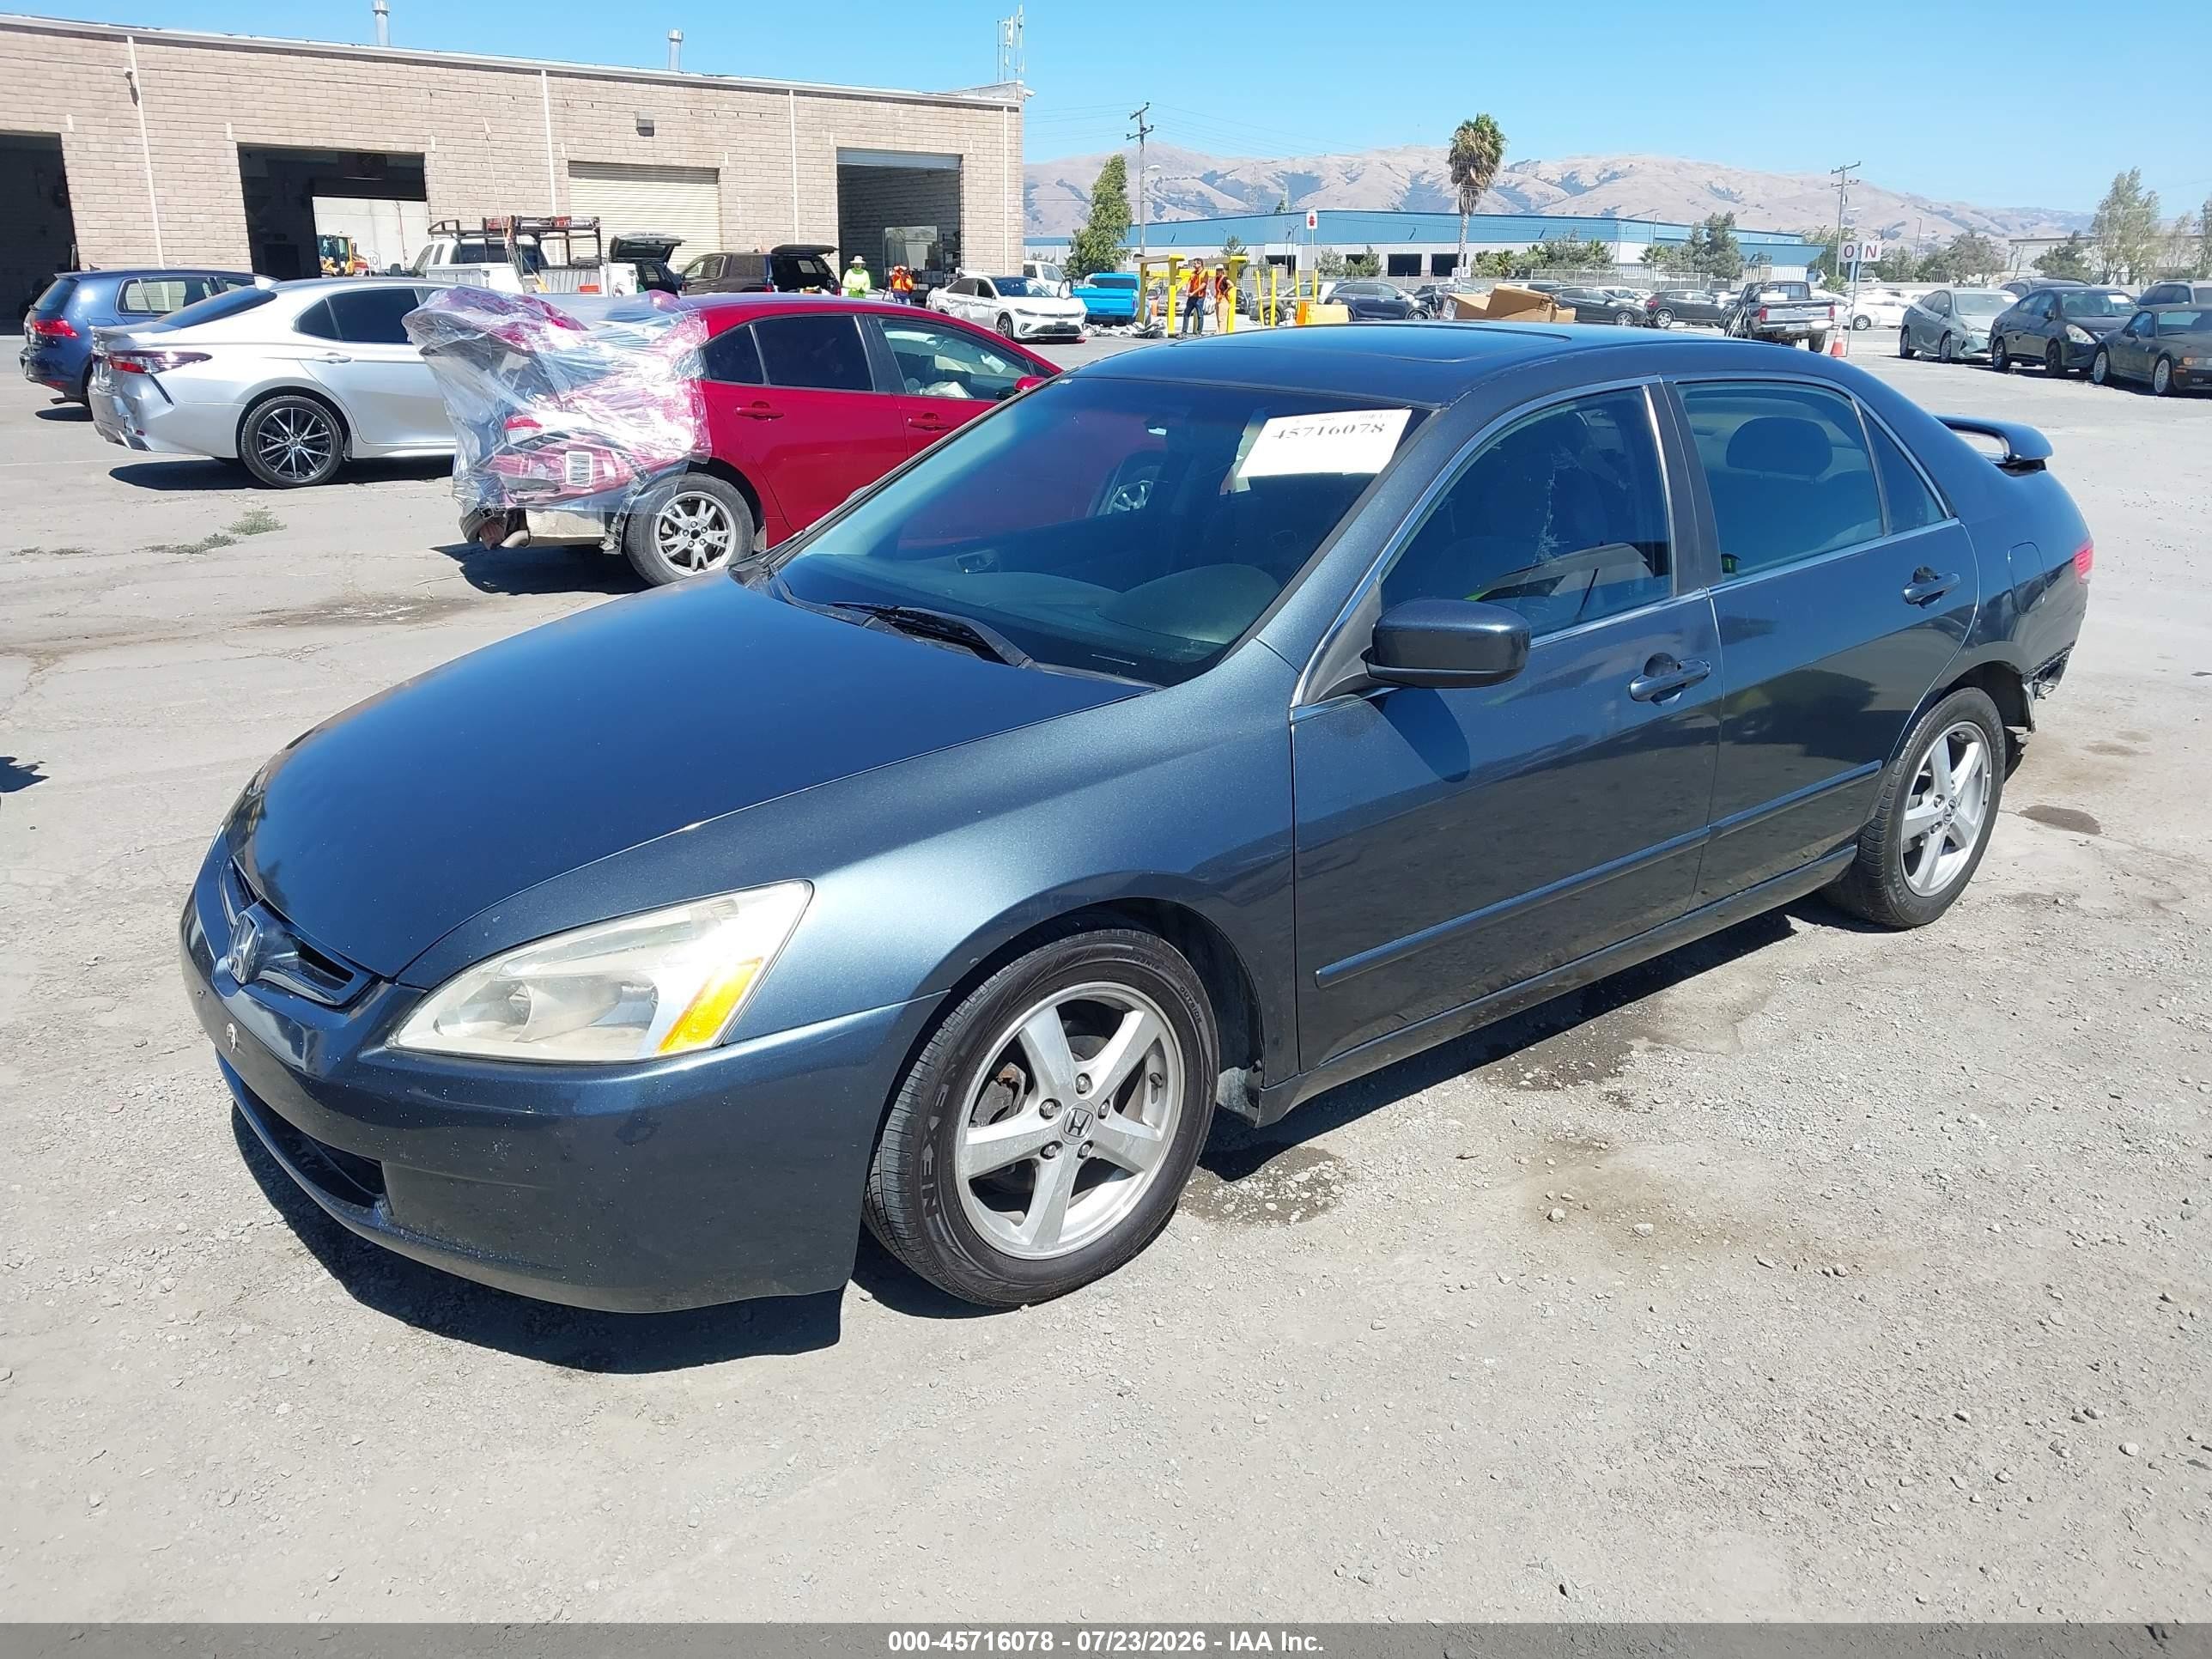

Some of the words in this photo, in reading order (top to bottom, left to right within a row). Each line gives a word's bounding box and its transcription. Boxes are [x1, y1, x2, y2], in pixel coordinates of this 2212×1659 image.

[1844, 244, 1855, 258] O
[1864, 244, 1878, 258] N
[1271, 422, 1385, 441] 45716078
